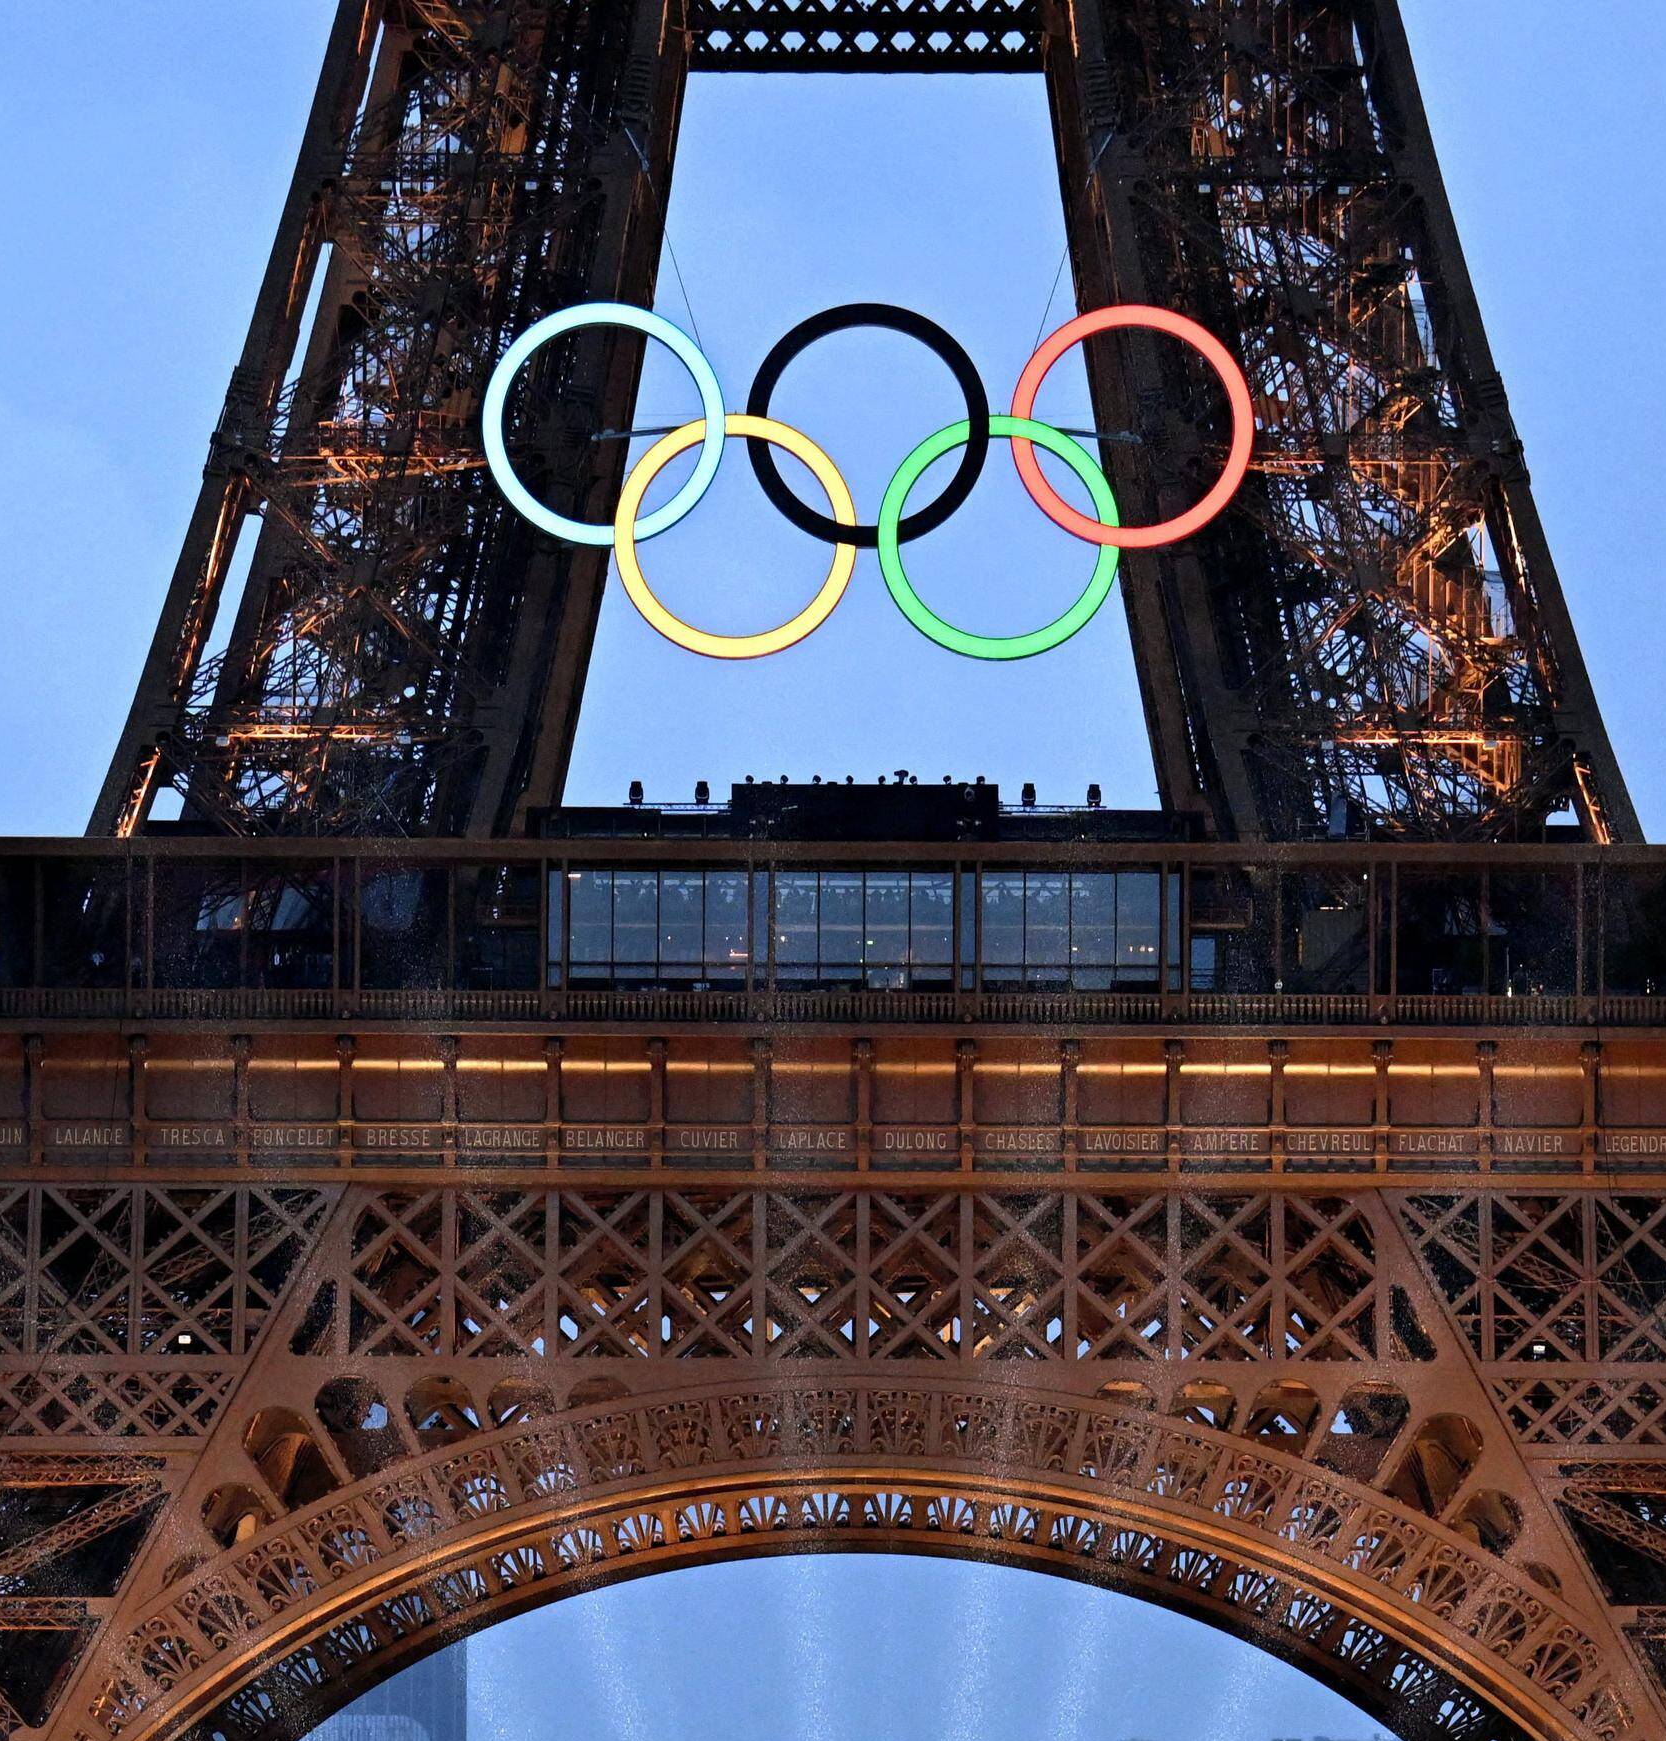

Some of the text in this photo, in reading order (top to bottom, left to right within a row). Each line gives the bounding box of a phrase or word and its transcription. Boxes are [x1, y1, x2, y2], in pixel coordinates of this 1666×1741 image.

[55, 1127, 123, 1145] LALANDE
[161, 1127, 226, 1145] TRESCA
[253, 1128, 334, 1146] PONCELET
[366, 1129, 431, 1146] BRESSE
[465, 1130, 540, 1148] LAGRANGE
[565, 1130, 644, 1148] BELANGER
[680, 1130, 738, 1148] CUVIER
[779, 1131, 846, 1149] LAPLACE
[884, 1131, 947, 1149] DULONG
[985, 1132, 1055, 1150] CHASLES
[1085, 1133, 1159, 1151] LAVOISIER
[1194, 1133, 1259, 1151] AMPERE
[1287, 1134, 1371, 1152] CHEVREUL
[1399, 1134, 1465, 1152] FLACHAT
[1503, 1135, 1563, 1153] NAVIER
